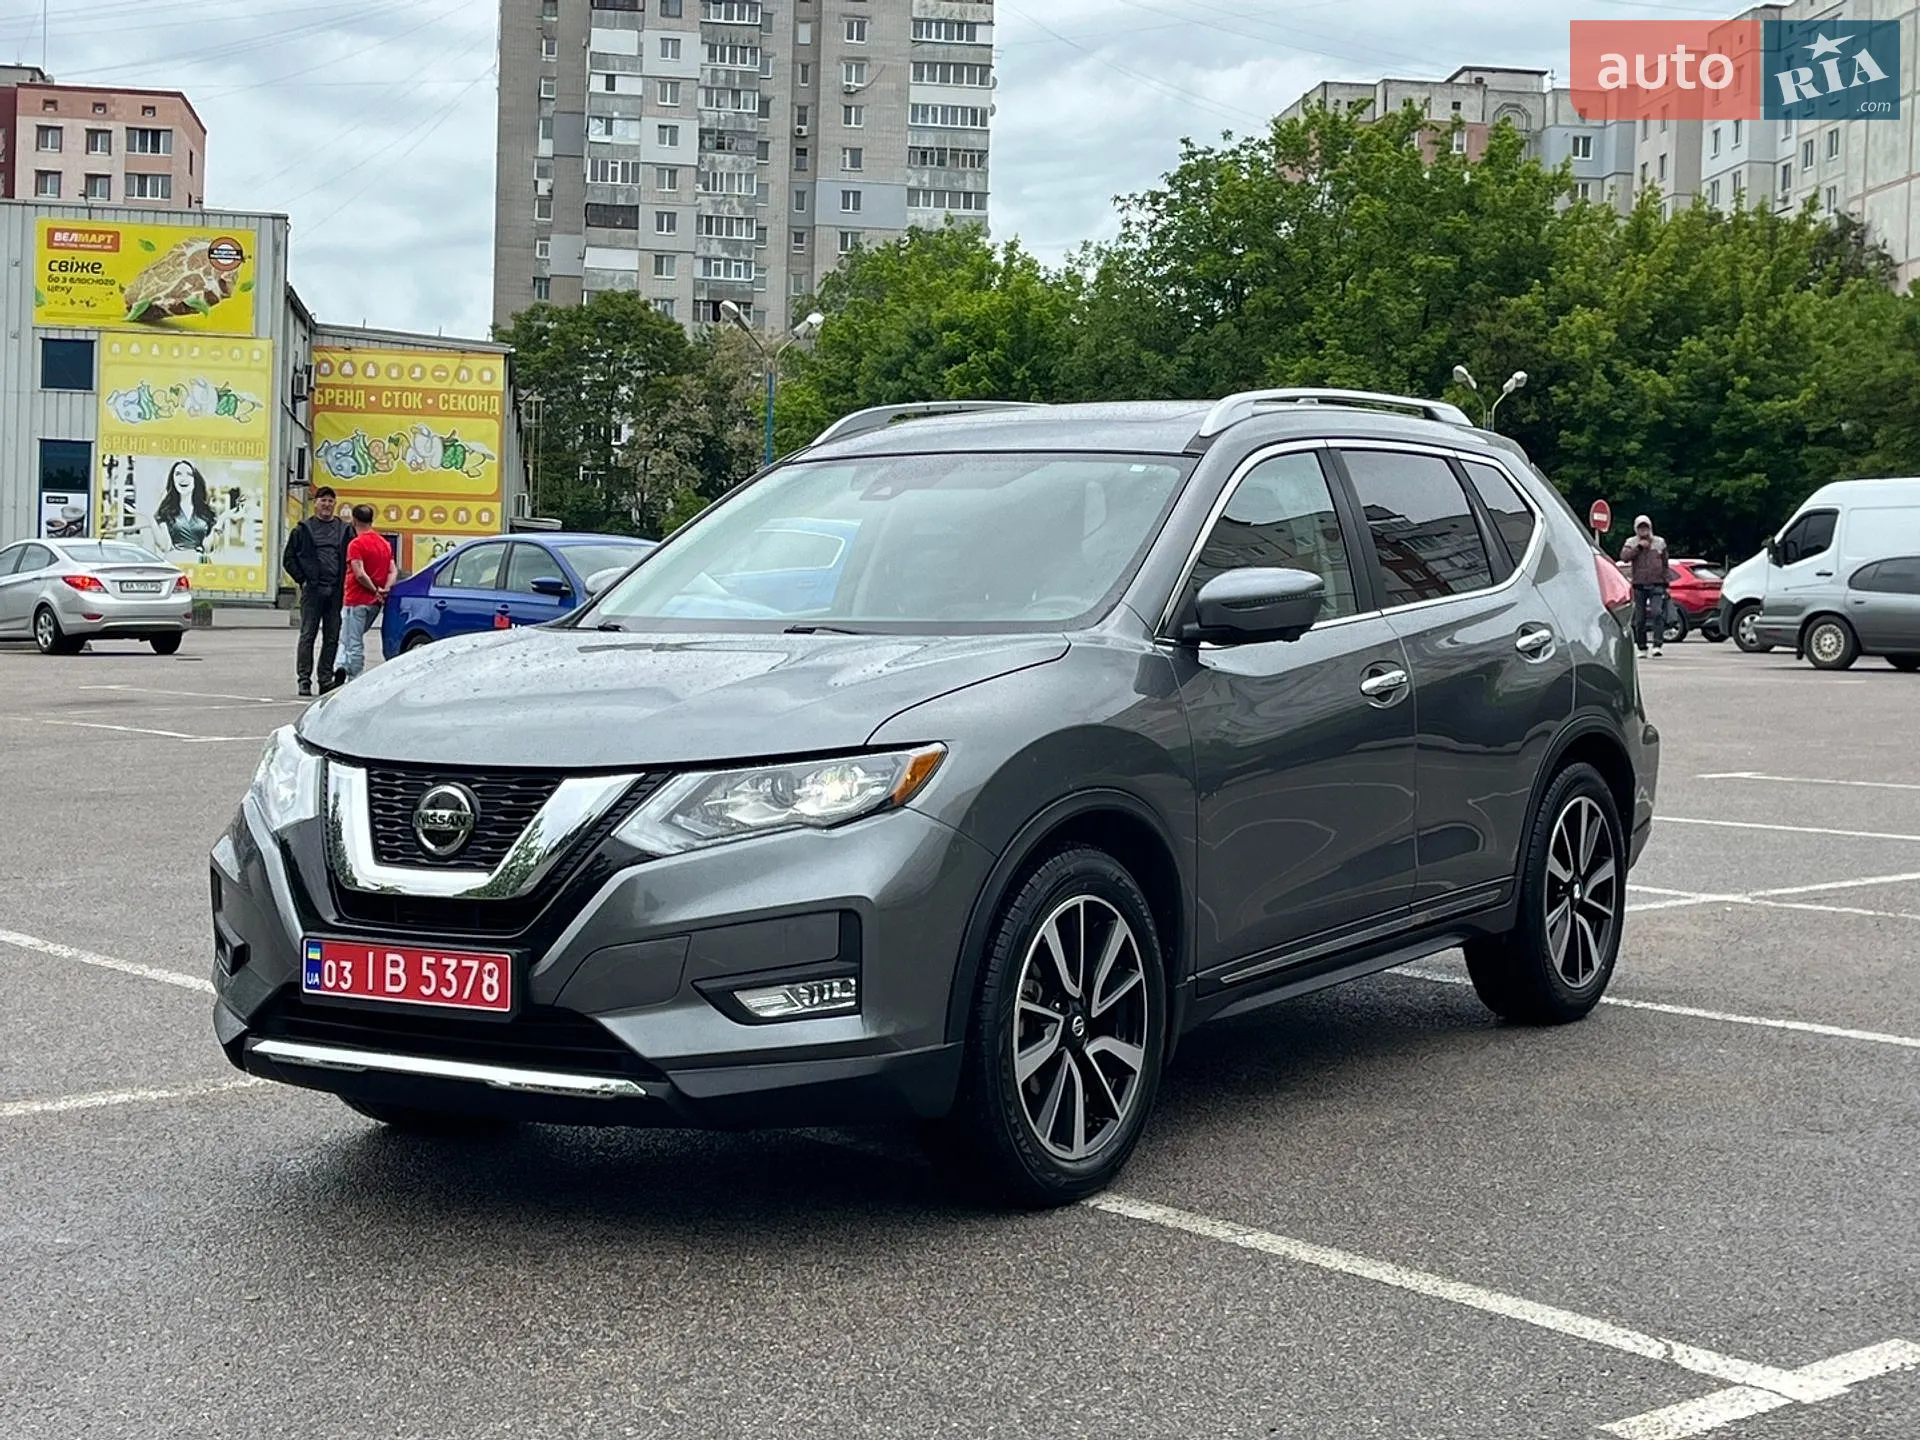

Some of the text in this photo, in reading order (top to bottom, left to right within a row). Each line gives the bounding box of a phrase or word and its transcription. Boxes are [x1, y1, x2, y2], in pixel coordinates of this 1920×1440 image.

[54, 232, 114, 244] ВЕЛМАРТ
[48, 256, 105, 276] свіже,
[314, 388, 500, 415] БРЕНД СТОК СЕКОНД
[103, 435, 264, 456] БРЕНД СТОК СЕКОНД
[418, 813, 467, 827] NISSAN
[306, 972, 320, 986] UA
[324, 959, 353, 990] 03
[419, 956, 500, 1002] 5378
